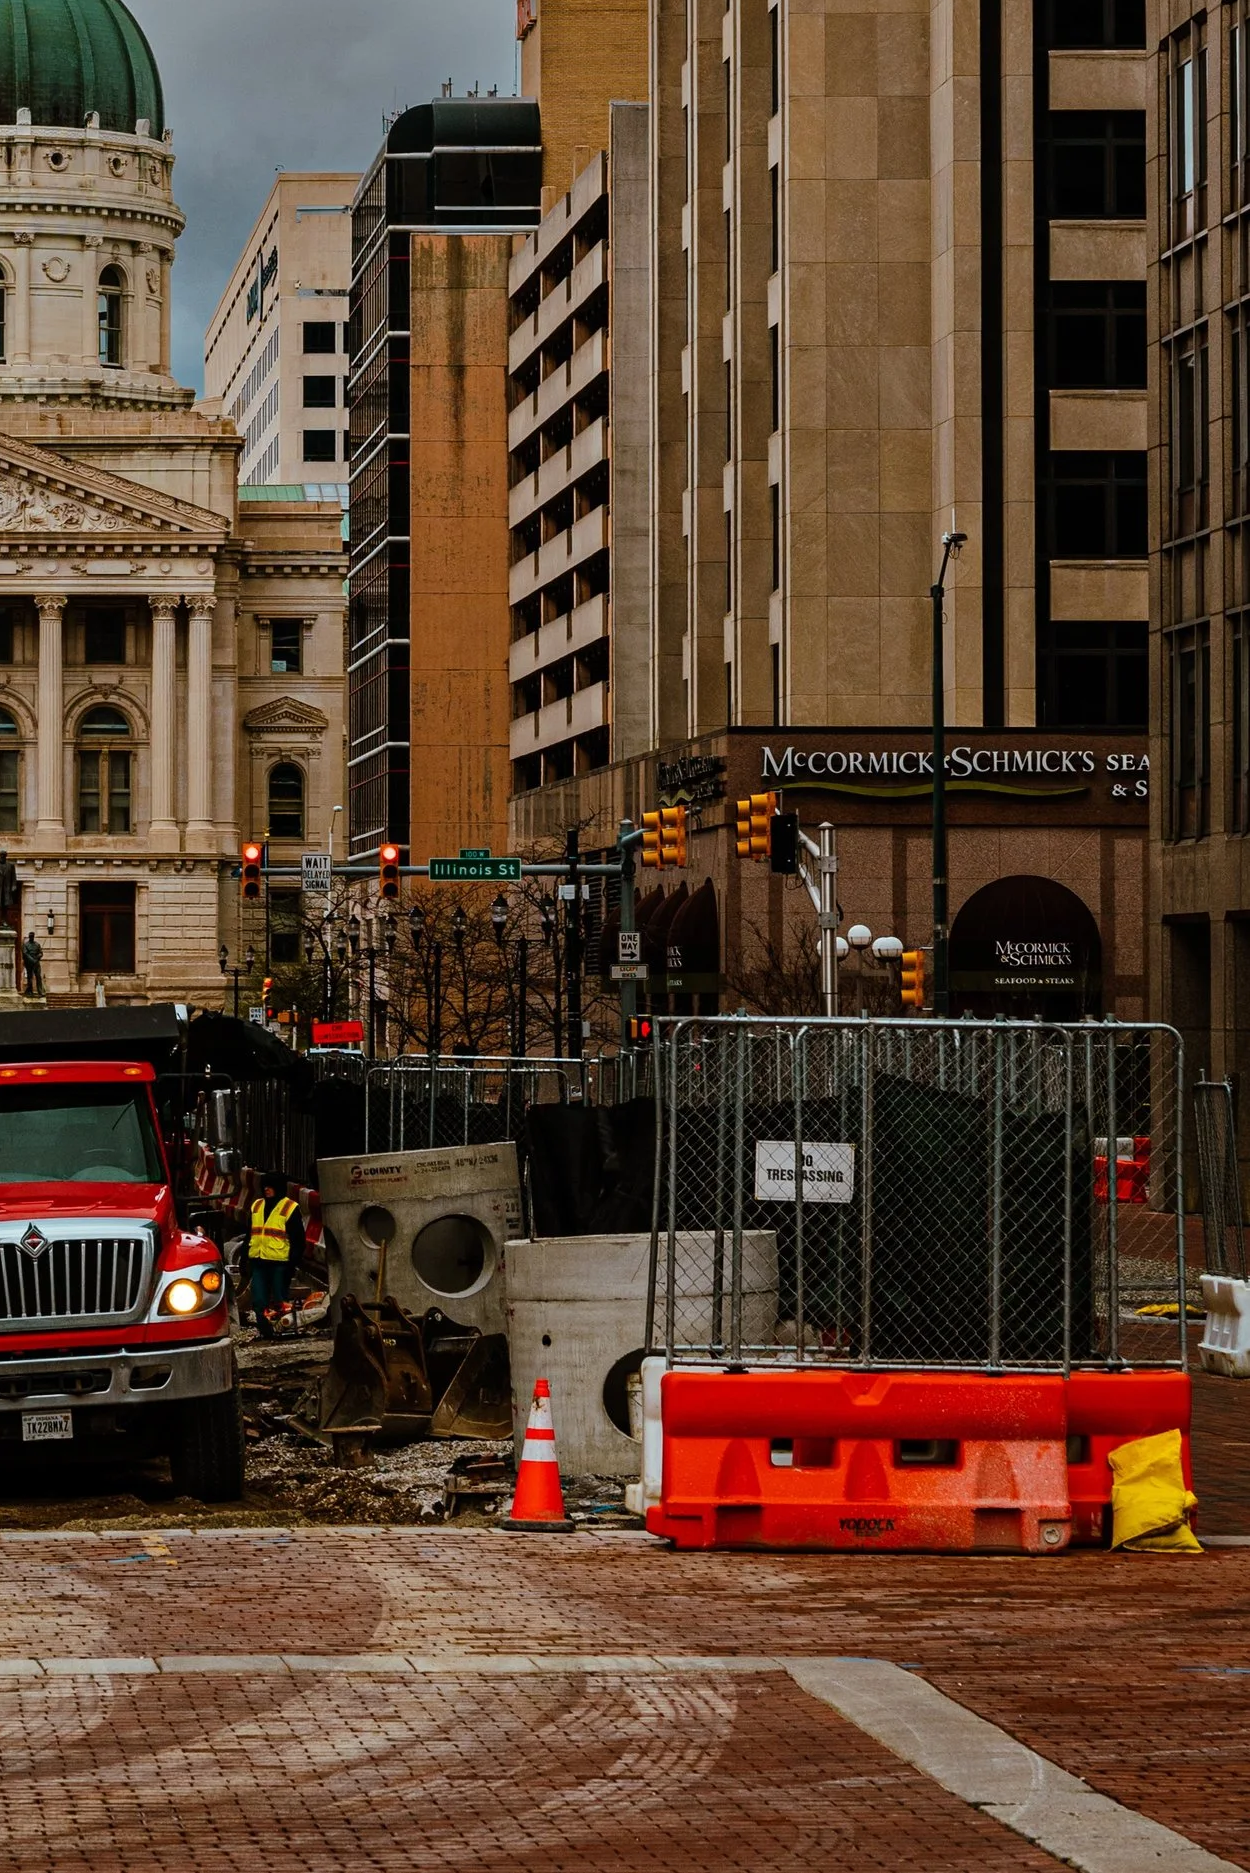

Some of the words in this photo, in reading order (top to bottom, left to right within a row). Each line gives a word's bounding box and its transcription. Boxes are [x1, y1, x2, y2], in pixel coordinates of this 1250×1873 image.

[950, 746, 1095, 777] SCHMICK'S
[305, 857, 328, 869] WAIT
[435, 864, 492, 875] Illinois
[498, 864, 515, 875] St
[305, 880, 328, 889] SIGNAL
[621, 934, 638, 942] ONE
[620, 942, 638, 950] WAY
[995, 977, 1037, 985] SEAFOOD
[1045, 977, 1075, 985] STEAKS
[766, 1168, 844, 1183] TRESASSING
